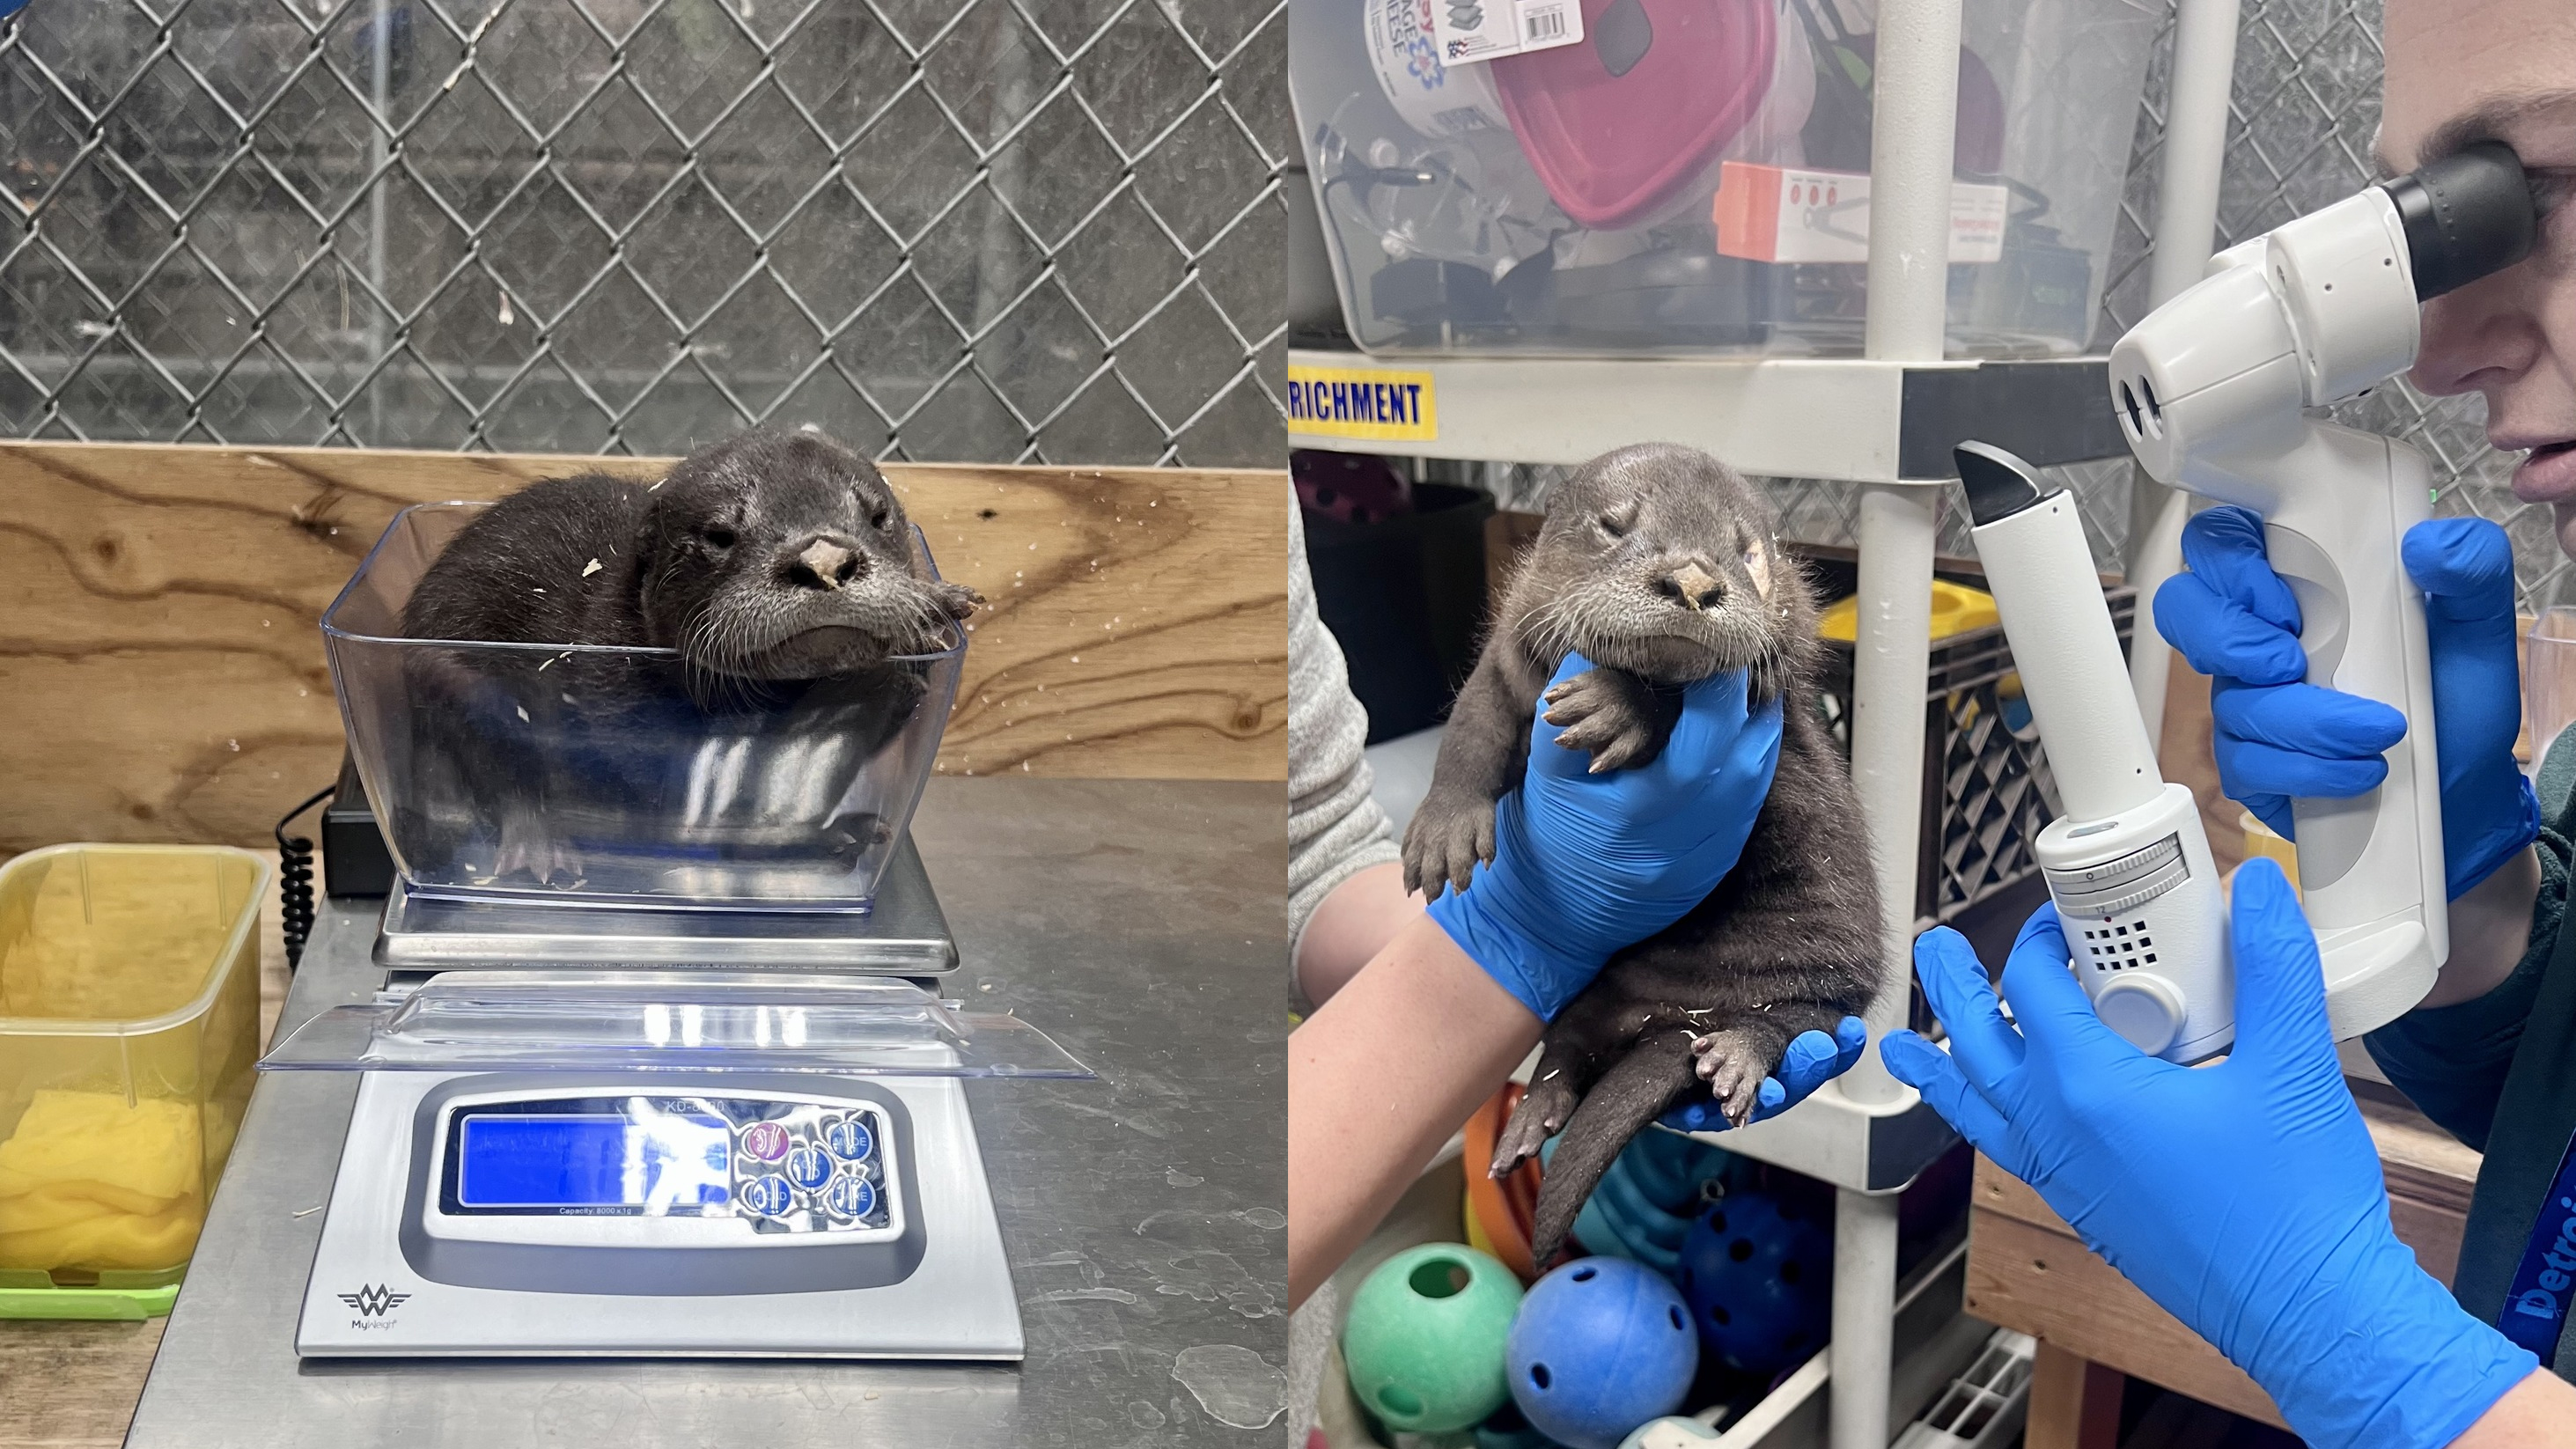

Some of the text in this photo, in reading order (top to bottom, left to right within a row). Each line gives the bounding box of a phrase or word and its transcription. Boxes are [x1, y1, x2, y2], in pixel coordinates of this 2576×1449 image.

[1289, 380, 1422, 425] RICHMENT
[559, 1207, 596, 1216] Capacity:
[622, 1207, 632, 1216] 1g
[2514, 1184, 2576, 1320] Detro
